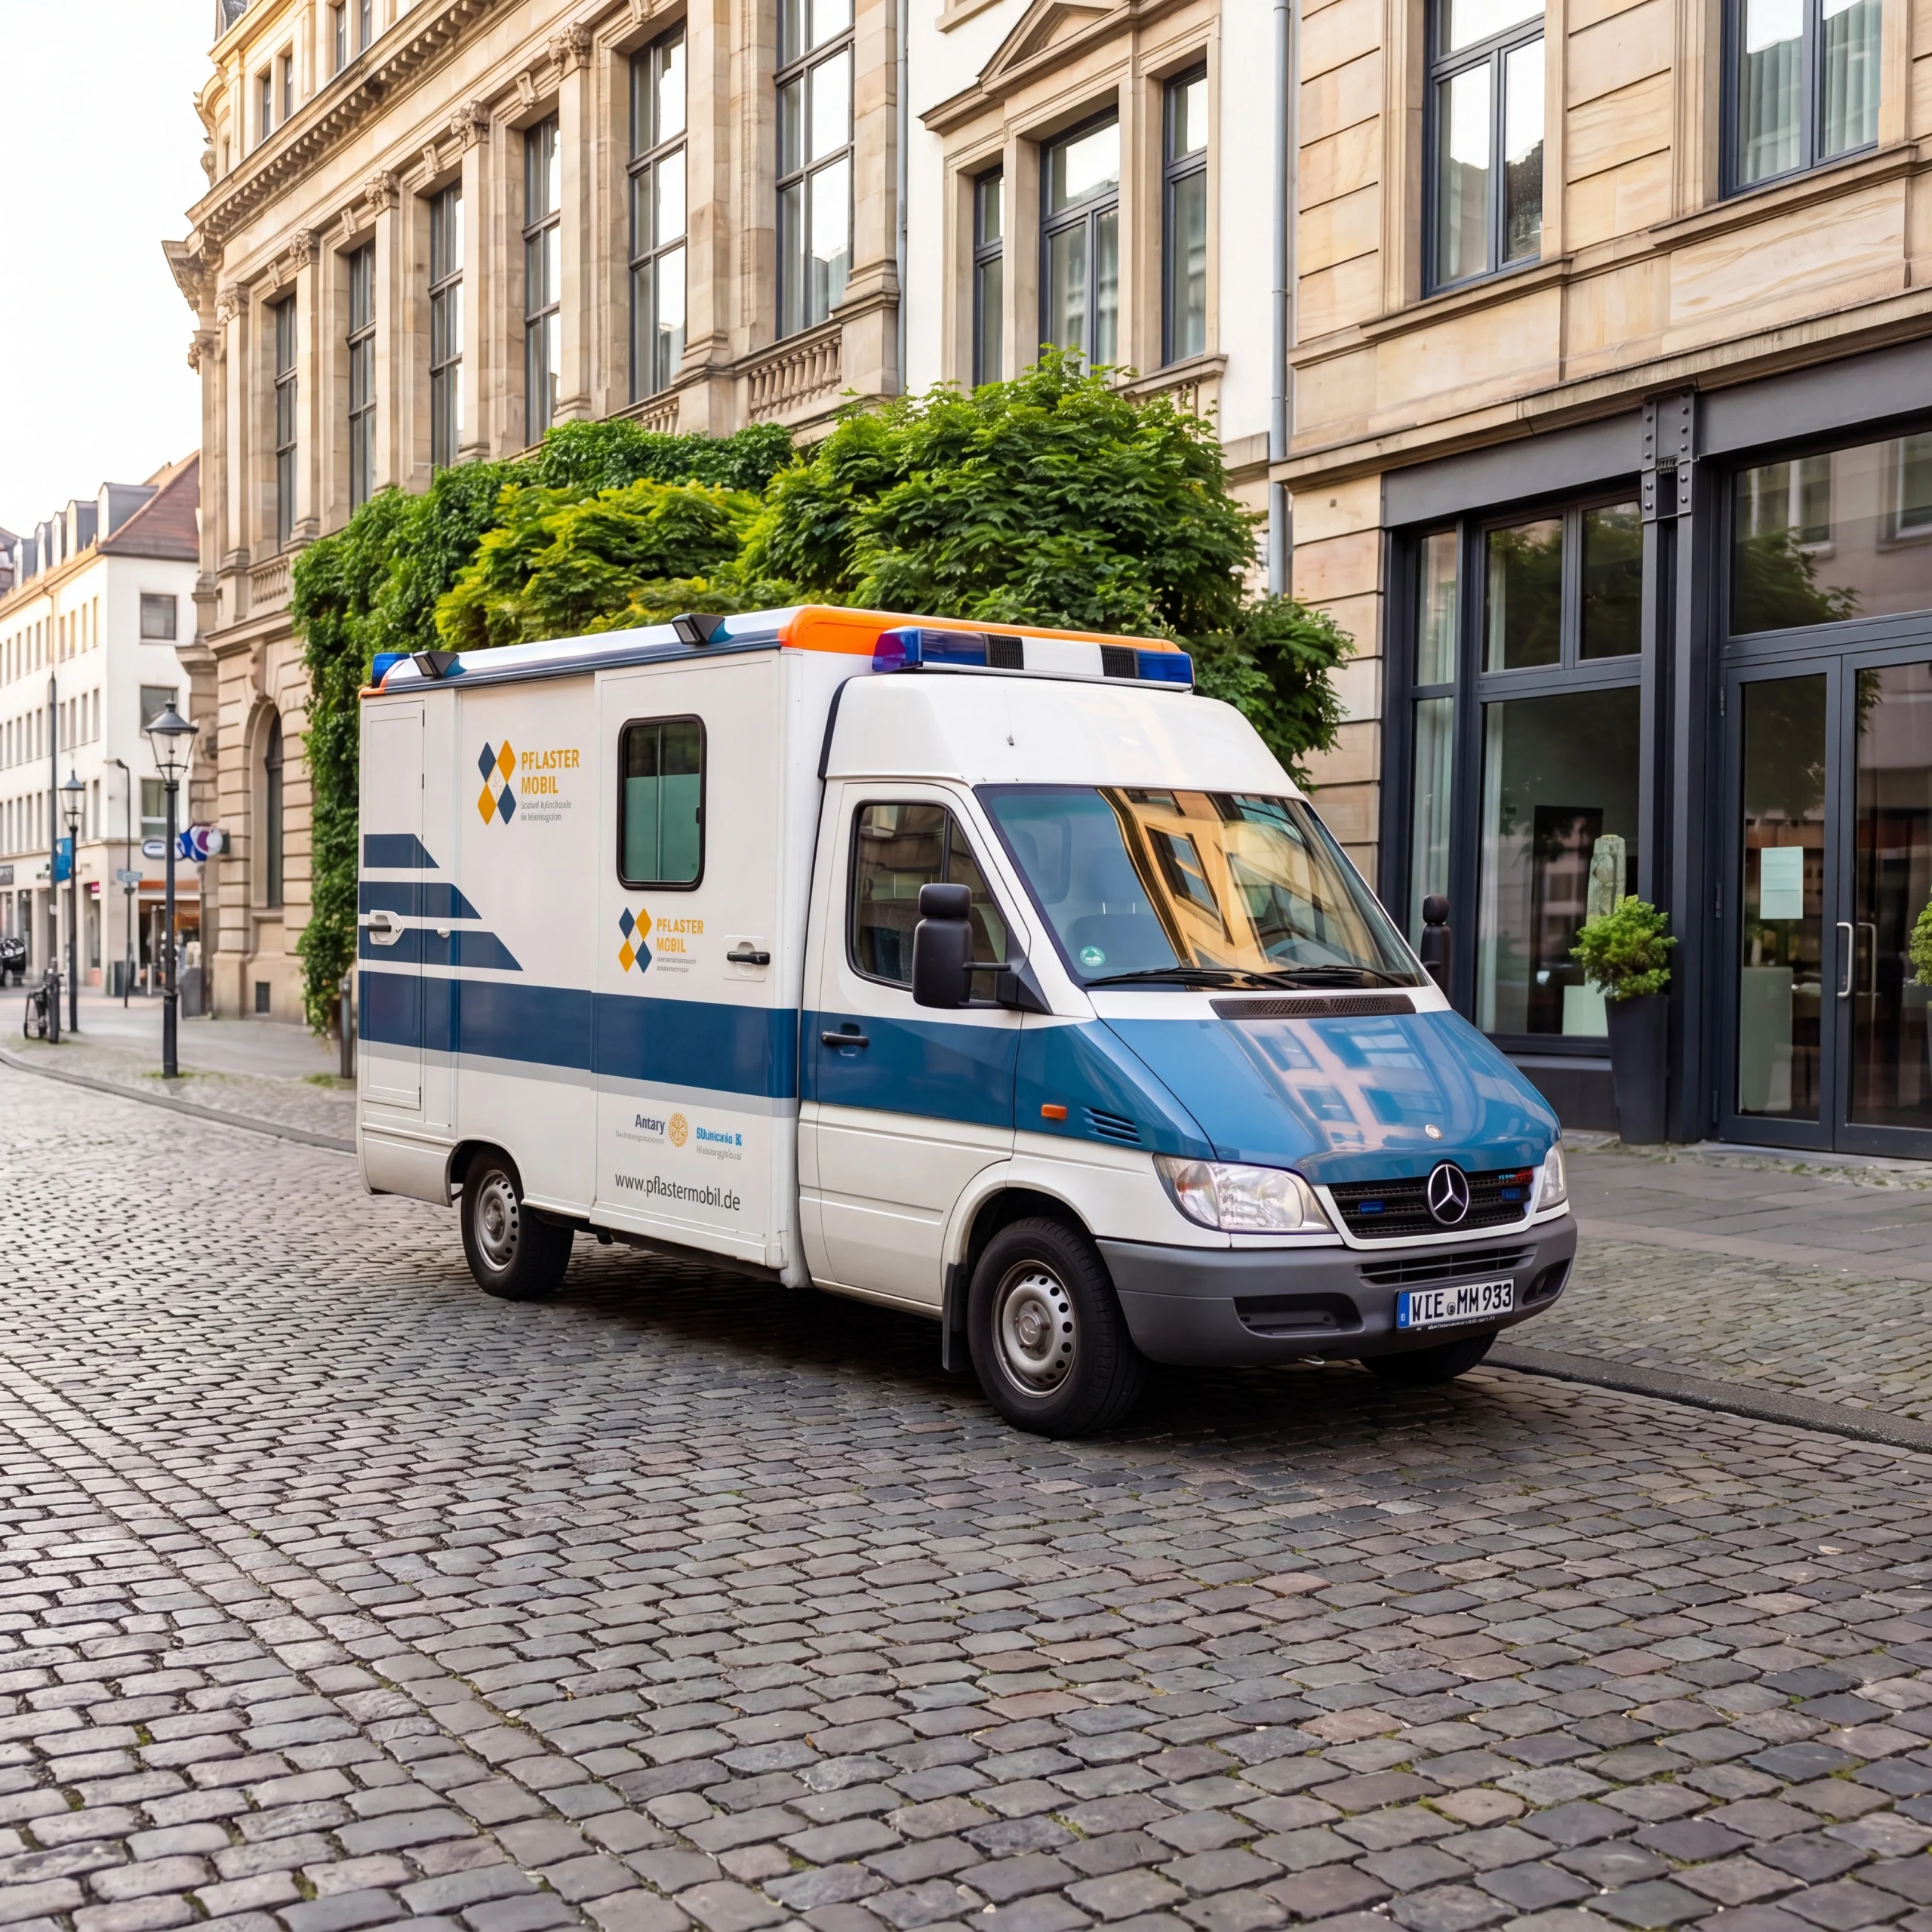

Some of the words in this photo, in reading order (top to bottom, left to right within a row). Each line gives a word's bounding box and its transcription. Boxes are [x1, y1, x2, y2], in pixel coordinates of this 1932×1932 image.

[521, 749, 580, 771] PFLASTER
[521, 776, 558, 795] MOBIL
[656, 918, 704, 935] PFLASTER
[615, 1174, 740, 1211] www.pflastermobil.de
[1457, 1287, 1479, 1315] MM
[1483, 1283, 1512, 1311] 933
